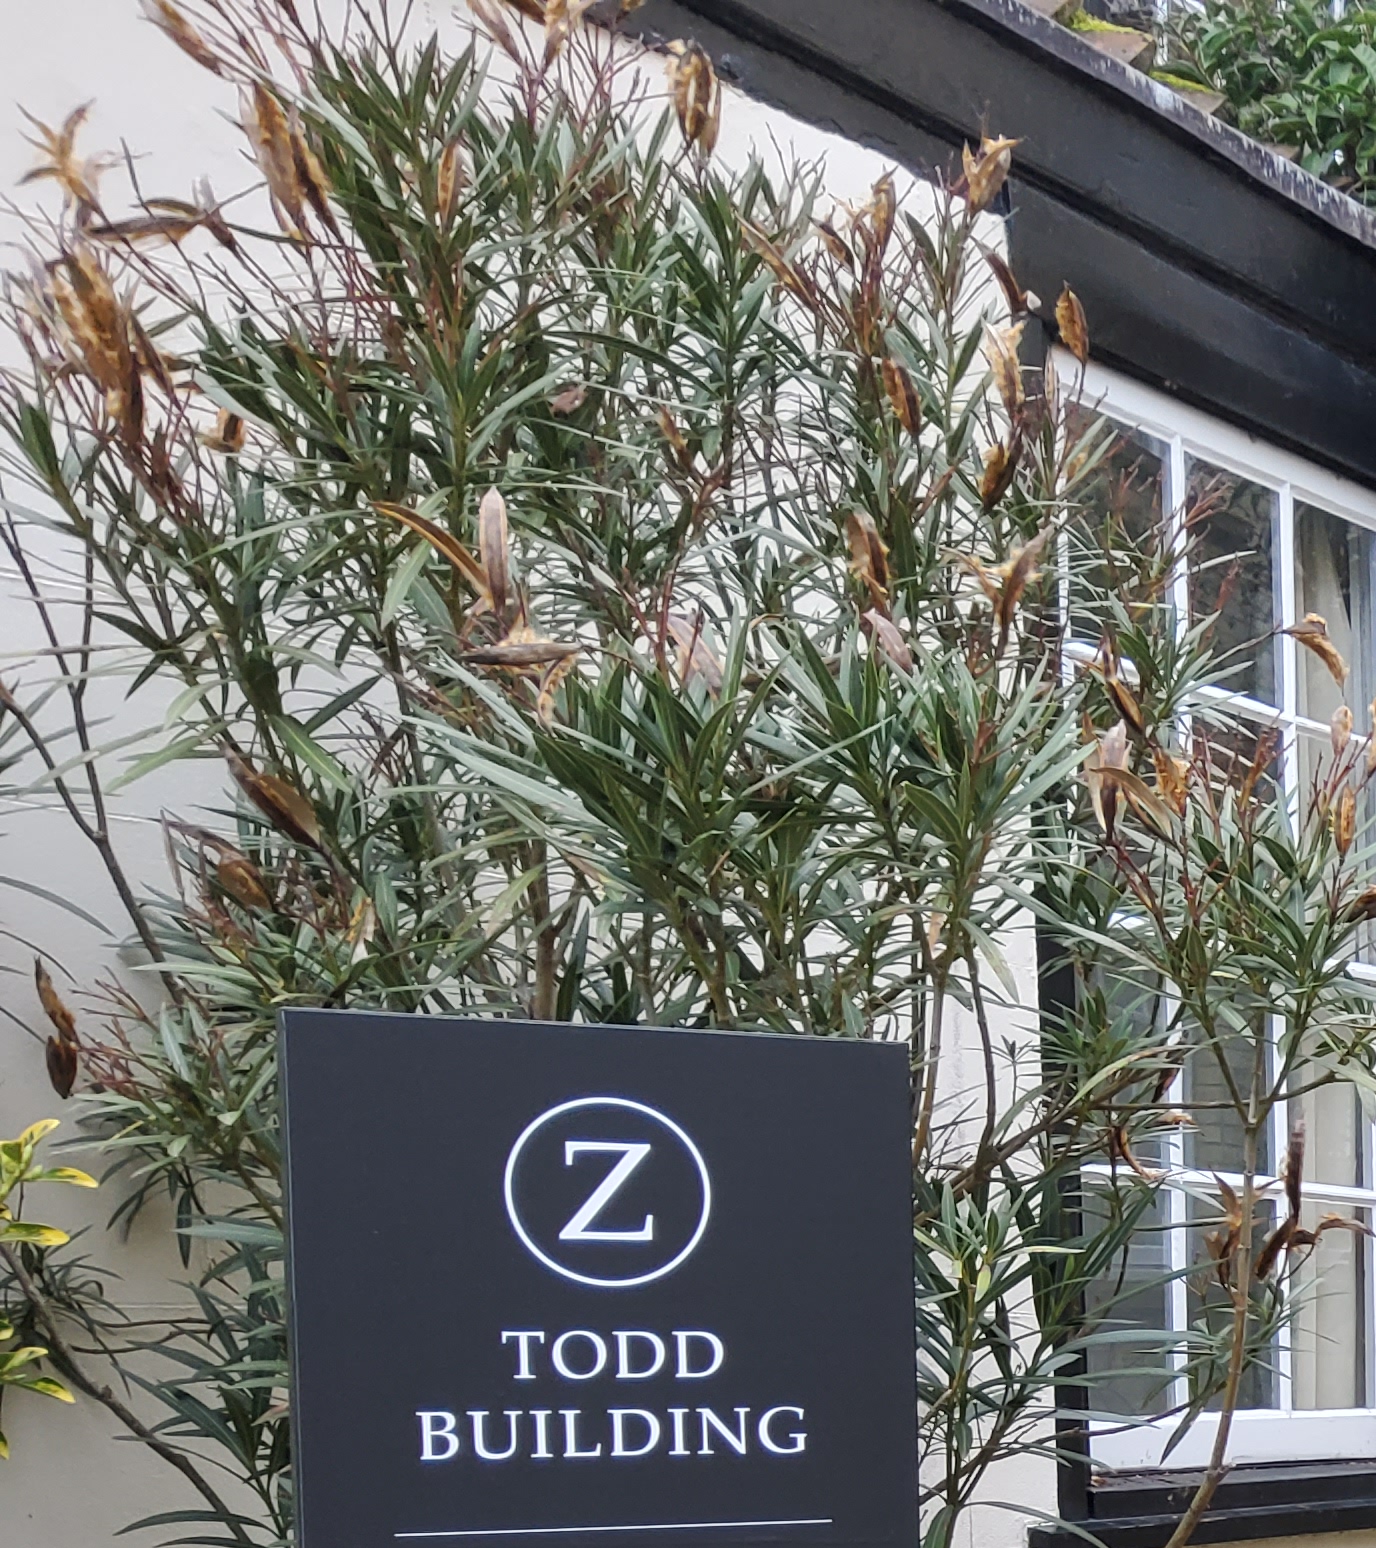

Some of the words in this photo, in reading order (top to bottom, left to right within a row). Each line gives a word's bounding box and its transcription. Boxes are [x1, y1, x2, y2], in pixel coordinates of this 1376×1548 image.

[557, 1139, 655, 1243] Z
[500, 1329, 726, 1381] TODD
[414, 1404, 809, 1462] BUILDING
